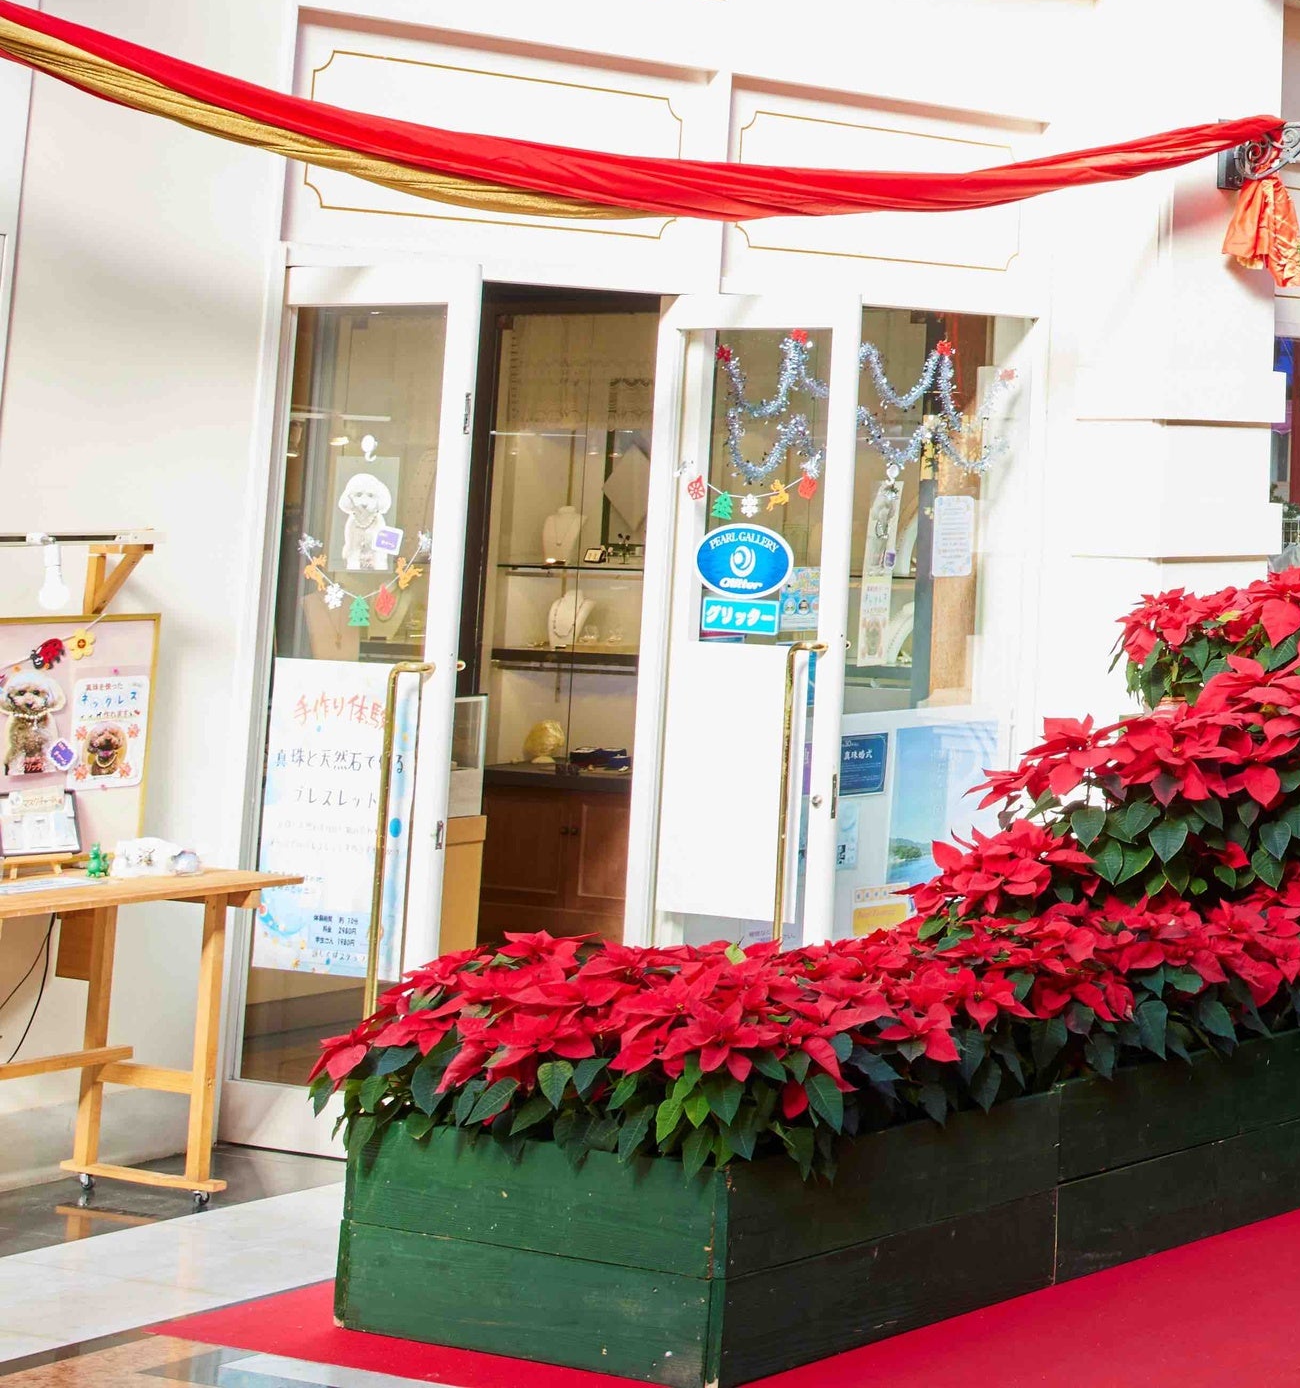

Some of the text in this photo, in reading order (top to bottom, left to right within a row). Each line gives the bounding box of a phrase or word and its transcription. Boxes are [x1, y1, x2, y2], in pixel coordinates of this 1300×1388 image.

[709, 531, 780, 553] PEARL GALLERY
[705, 605, 775, 627] グリッター
[276, 747, 404, 775] 真珠と天然石でる
